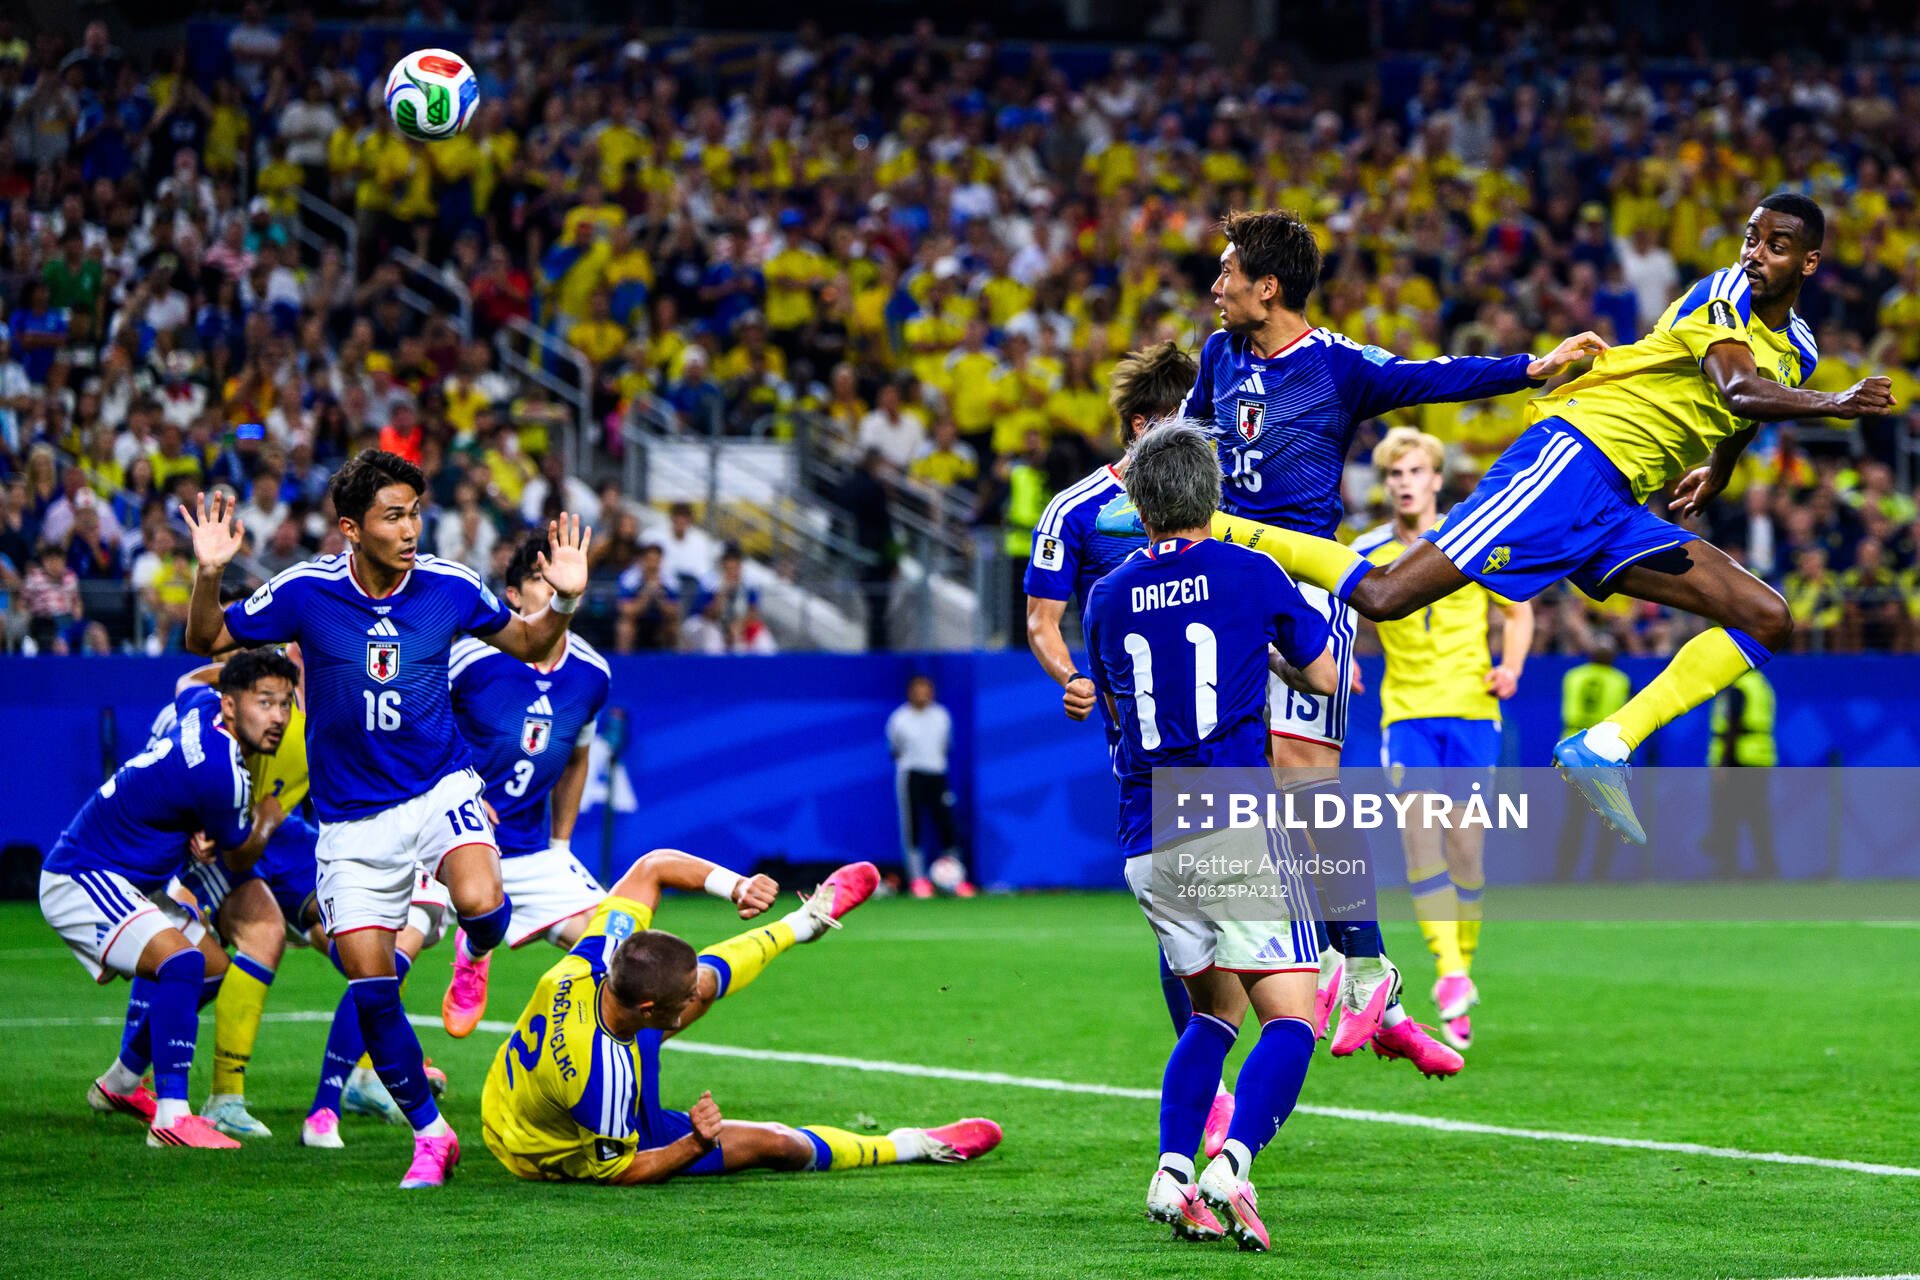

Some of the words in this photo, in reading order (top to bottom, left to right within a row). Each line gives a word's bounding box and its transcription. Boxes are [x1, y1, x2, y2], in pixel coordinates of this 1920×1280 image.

[1131, 574, 1209, 613] DAIZEN
[1123, 622, 1218, 750] 11
[363, 689, 401, 731] 16
[504, 759, 535, 797] 3
[445, 799, 484, 836] 16
[505, 1013, 547, 1091] 2
